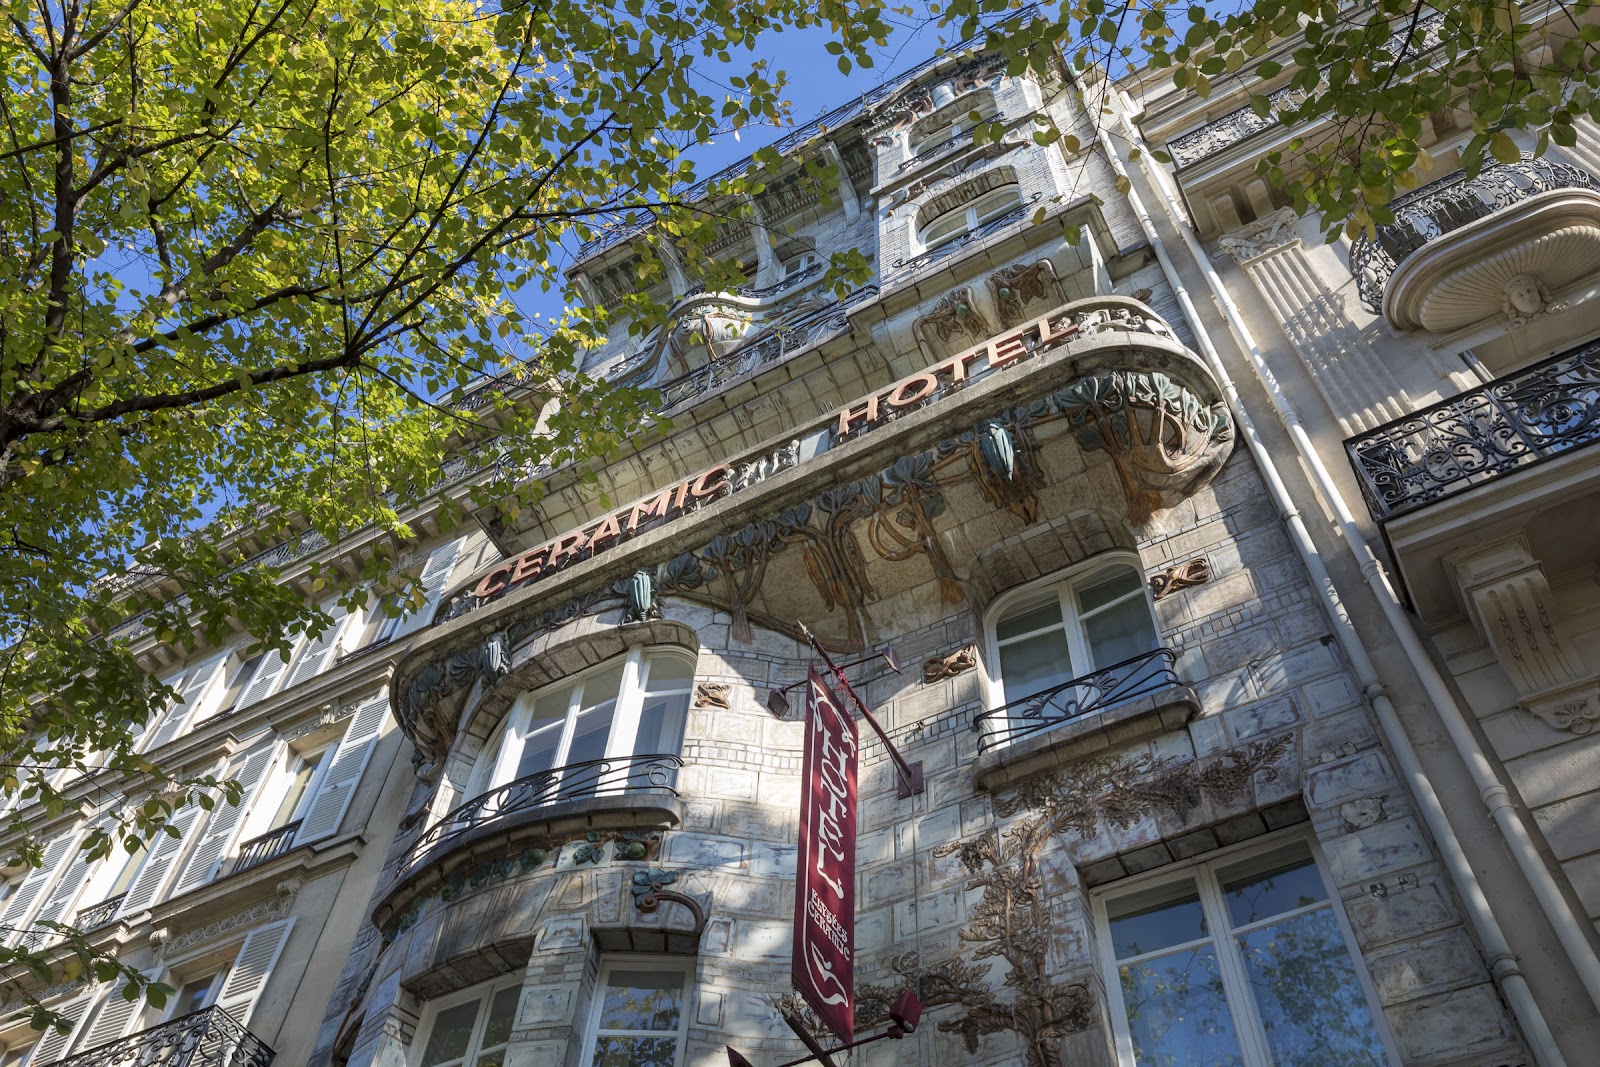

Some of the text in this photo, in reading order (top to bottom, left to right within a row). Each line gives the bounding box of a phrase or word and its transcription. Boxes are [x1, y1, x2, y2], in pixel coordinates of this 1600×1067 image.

[474, 318, 1079, 597] CERAMIC HOTEL
[817, 725, 849, 899] HOTEL
[807, 900, 850, 961] CERAMIC
